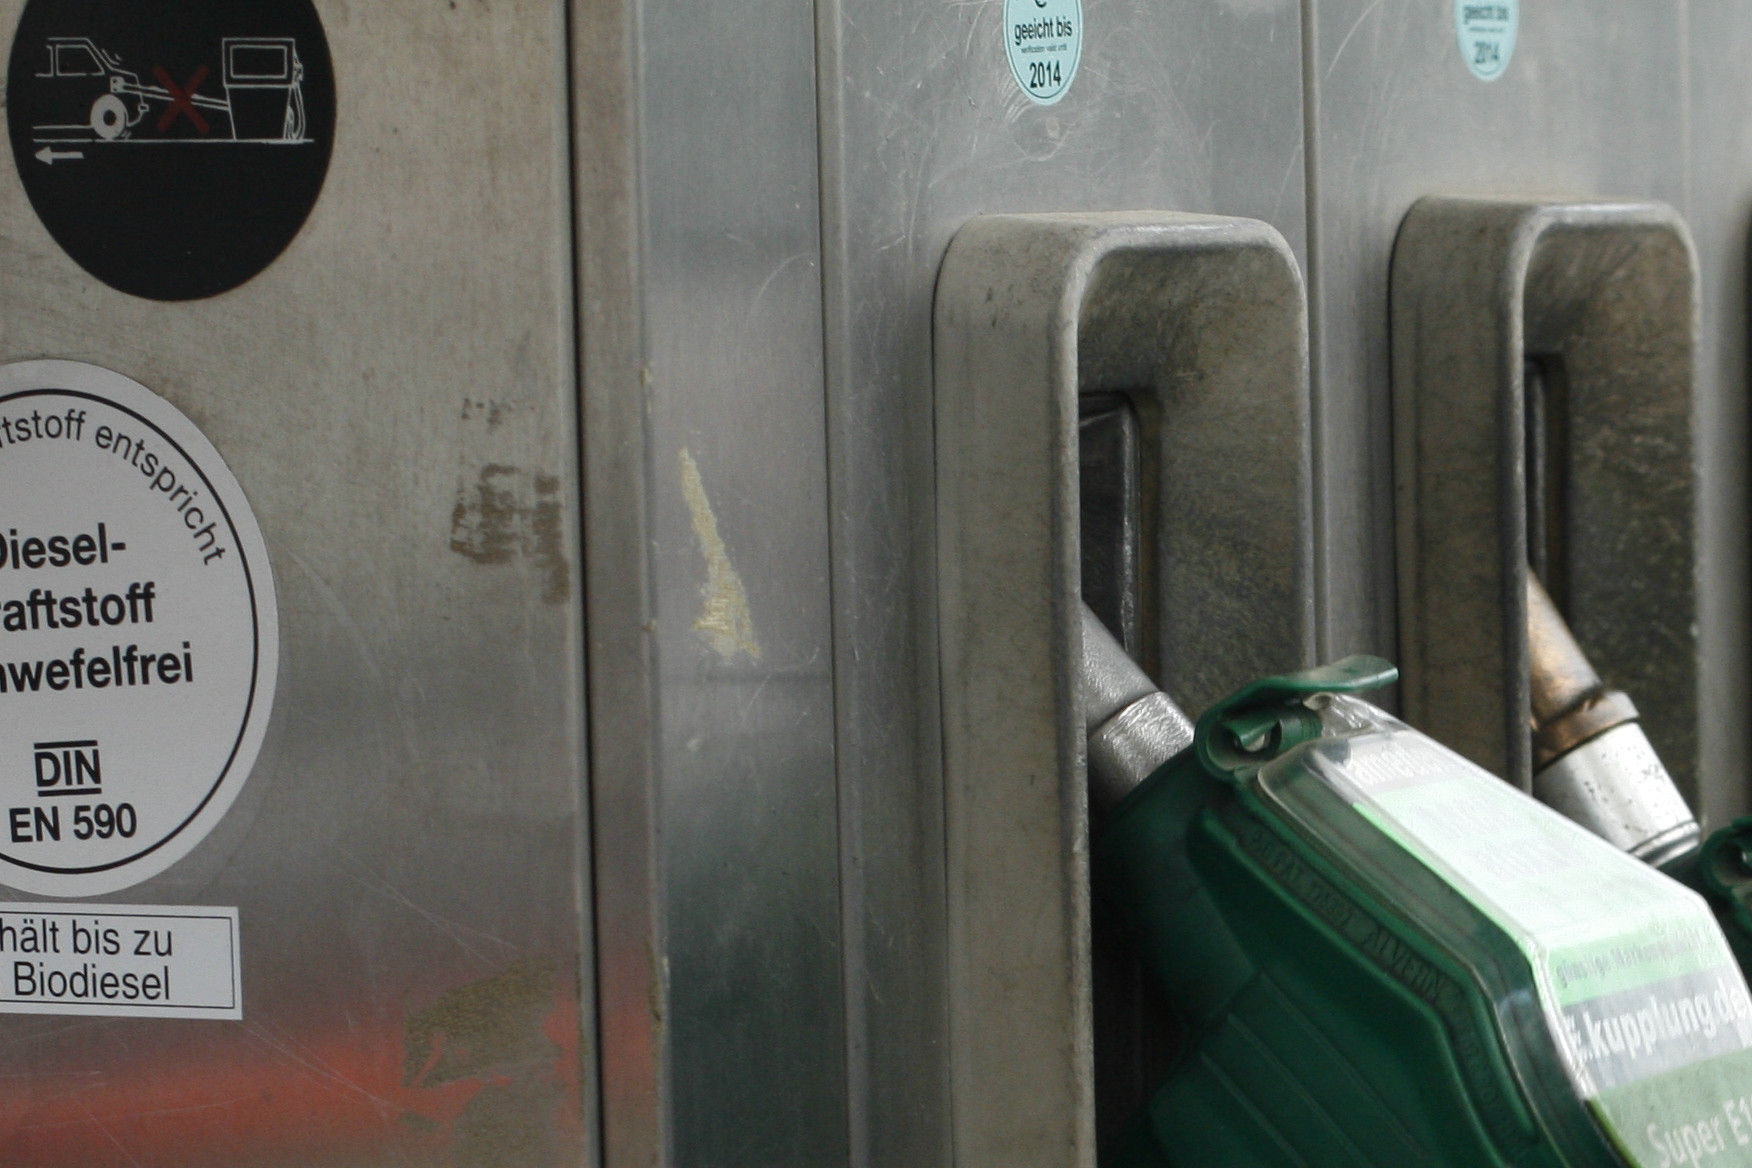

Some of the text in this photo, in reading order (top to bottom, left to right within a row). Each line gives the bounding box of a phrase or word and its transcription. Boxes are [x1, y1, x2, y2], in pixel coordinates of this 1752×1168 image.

[1014, 15, 1073, 46] geeicht bis
[1029, 60, 1062, 89] 2014
[0, 409, 227, 566] tstoff entspricht
[0, 581, 156, 632] aftstoff
[34, 748, 102, 788] DIN
[9, 802, 138, 843] EN 590
[0, 918, 173, 957] hält bis zu
[14, 961, 170, 1000] Biodiesel
